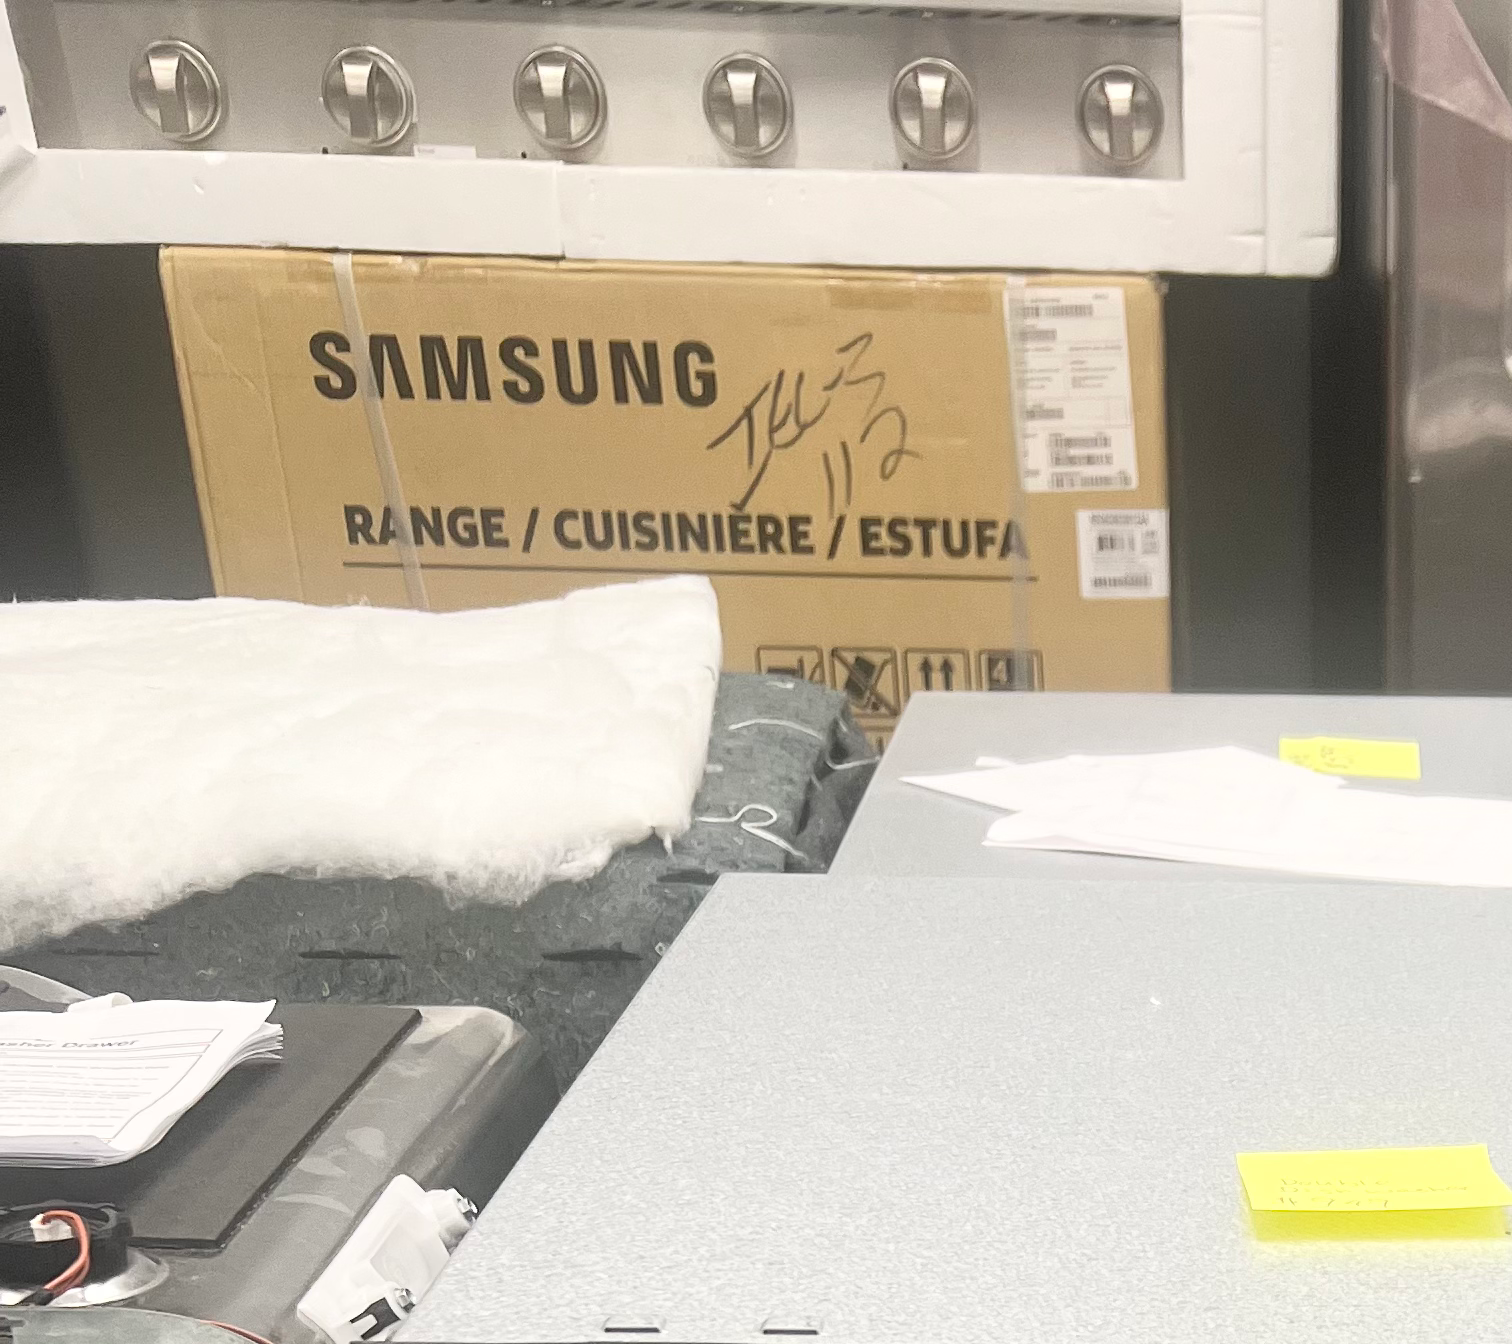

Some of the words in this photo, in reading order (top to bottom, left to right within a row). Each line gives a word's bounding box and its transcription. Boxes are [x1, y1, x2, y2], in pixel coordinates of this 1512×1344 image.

[309, 330, 718, 408] SAMSUNG
[343, 503, 510, 548] RANGE
[859, 516, 1028, 560] ESTUFA
